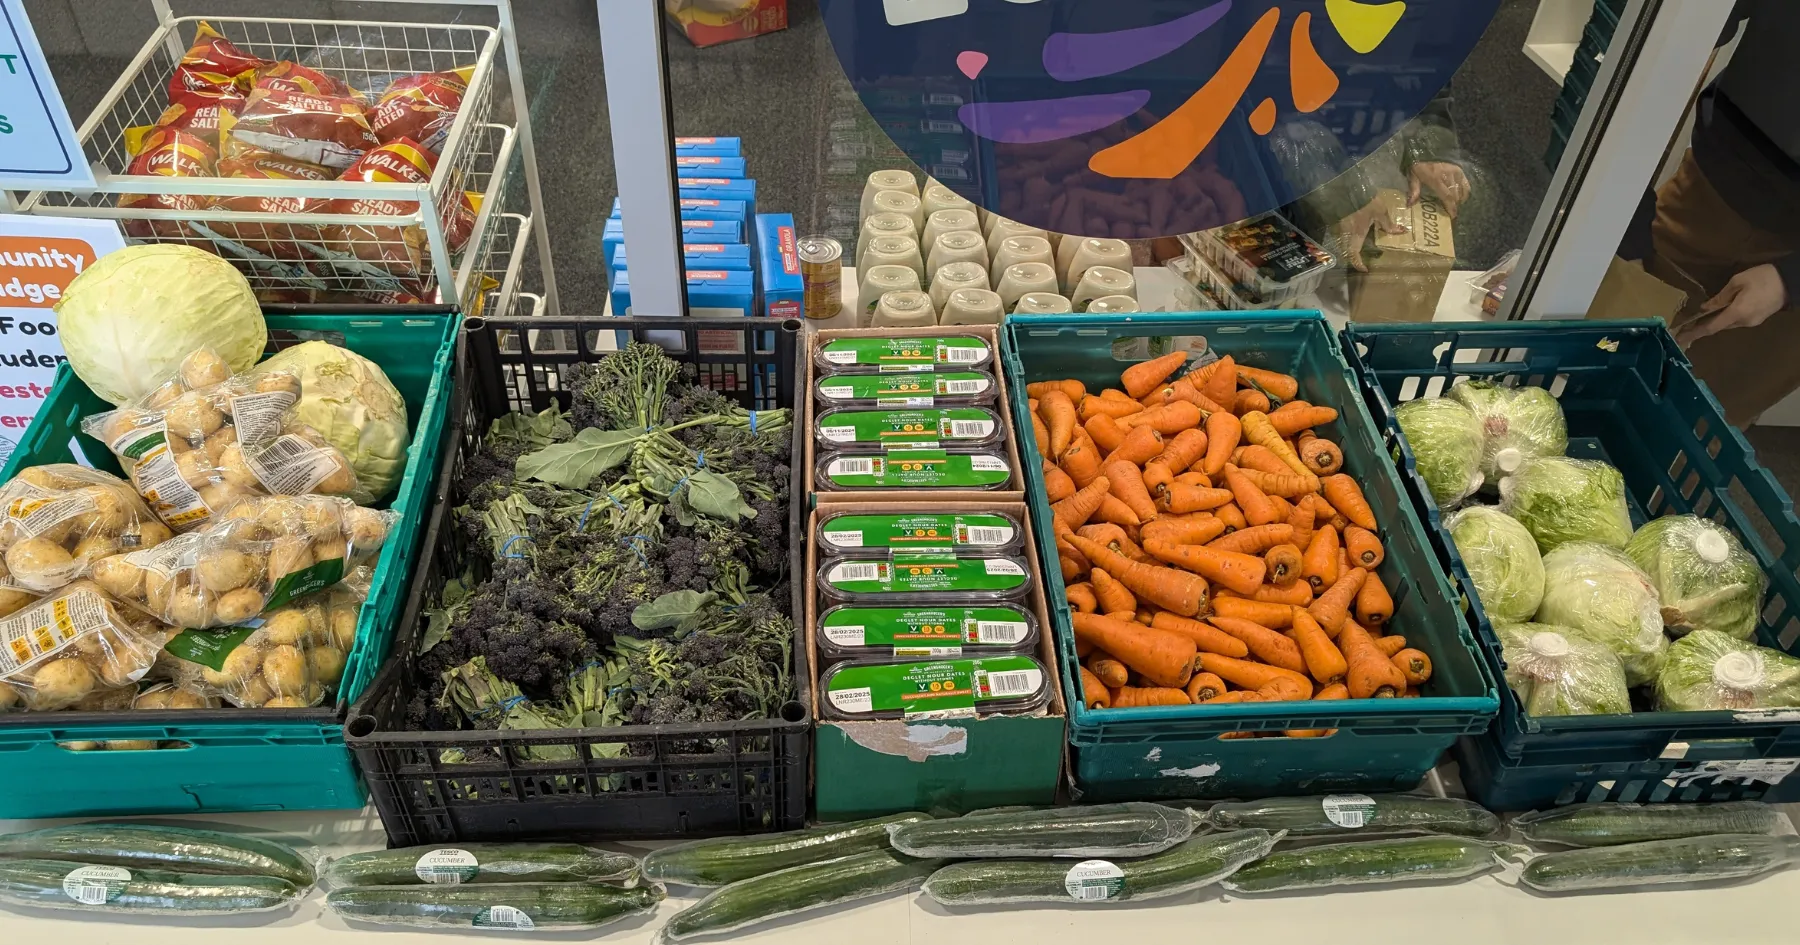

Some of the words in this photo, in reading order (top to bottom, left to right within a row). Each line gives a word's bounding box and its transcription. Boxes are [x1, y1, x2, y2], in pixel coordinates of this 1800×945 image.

[287, 100, 333, 111] SALTED
[289, 95, 330, 105] READY
[783, 228, 793, 252] GRANOLA
[0, 316, 59, 336] Foo
[0, 349, 69, 368] uden
[0, 415, 35, 428] er
[835, 691, 871, 700] 28/02/2025
[80, 870, 120, 878] CUCUMBER
[1076, 869, 1112, 878] CUCUMBER
